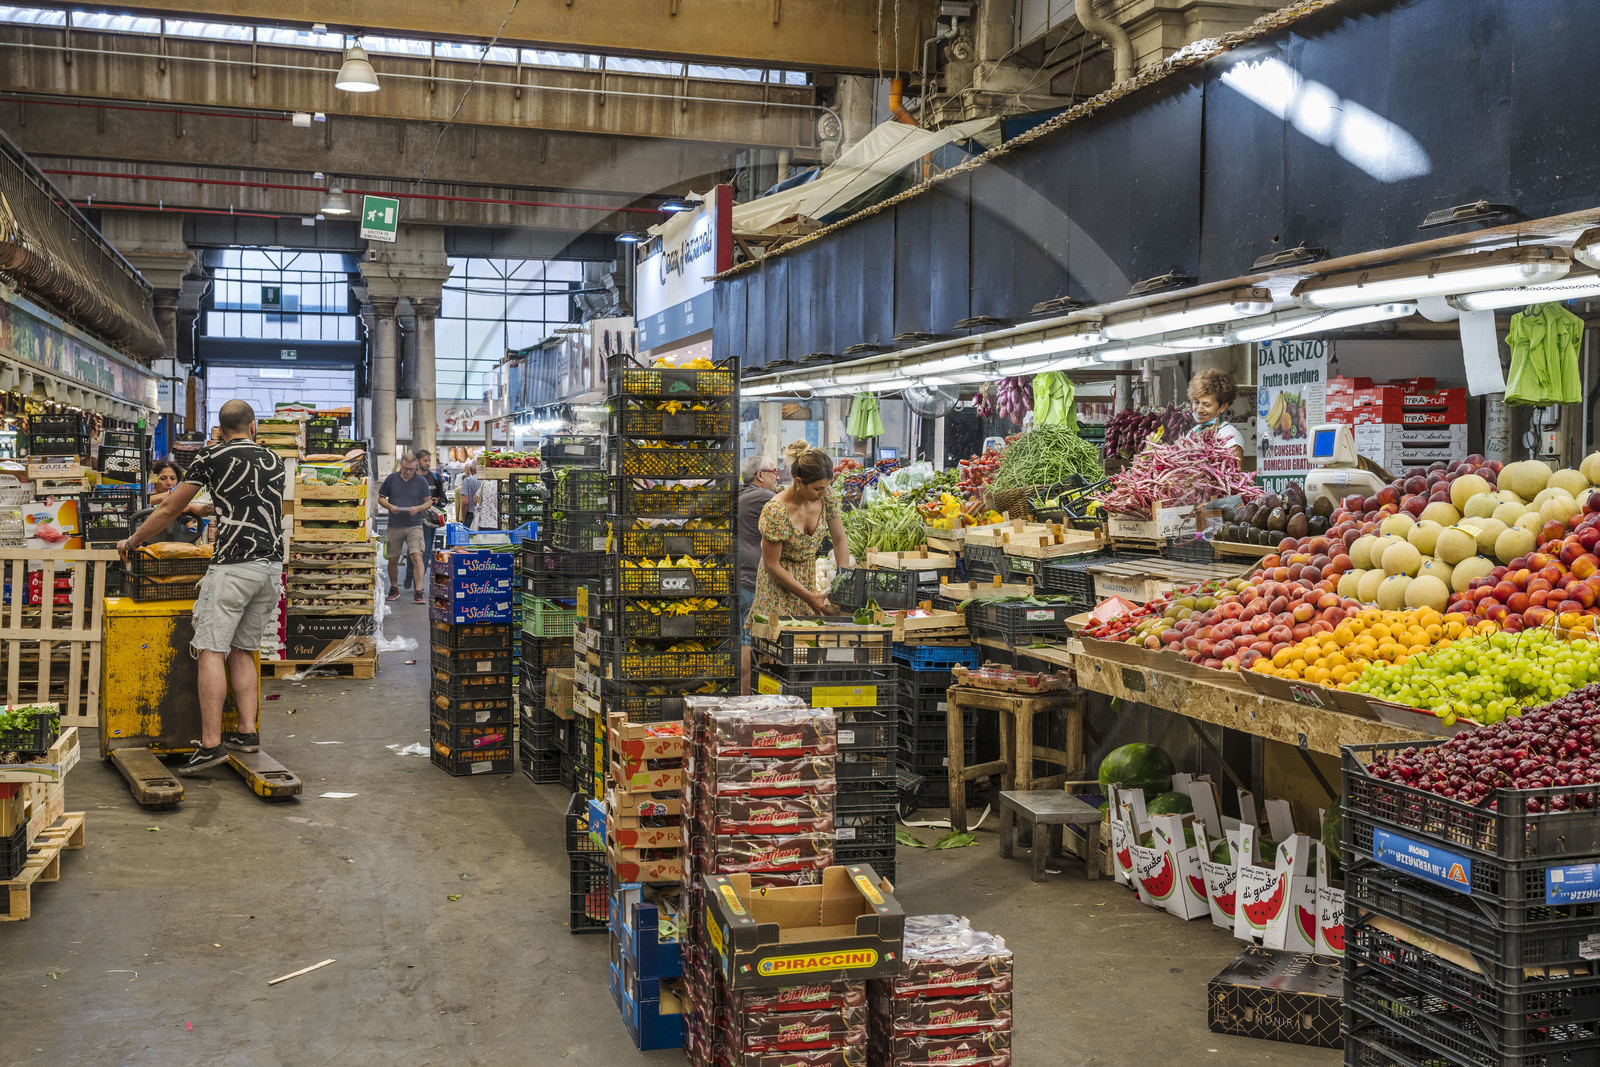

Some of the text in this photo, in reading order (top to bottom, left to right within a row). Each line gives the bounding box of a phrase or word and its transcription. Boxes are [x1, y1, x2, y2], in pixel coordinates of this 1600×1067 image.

[1259, 340, 1325, 368] DA RENZO
[1263, 368, 1320, 388] frutta e verdura
[1274, 444, 1308, 457] CONSEGNE A
[1263, 459, 1292, 471] DOMICILIO
[468, 557, 496, 571] Sicilia
[467, 580, 495, 594] Sicilia
[467, 604, 495, 618] Sicilia
[1409, 844, 1430, 858] GENOVA
[1143, 854, 1162, 877] gusto
[1218, 870, 1237, 895] gusto
[1253, 876, 1278, 902] gusto
[1243, 886, 1252, 899] di
[1321, 908, 1331, 921] di
[773, 952, 872, 971] PIRACCINI
